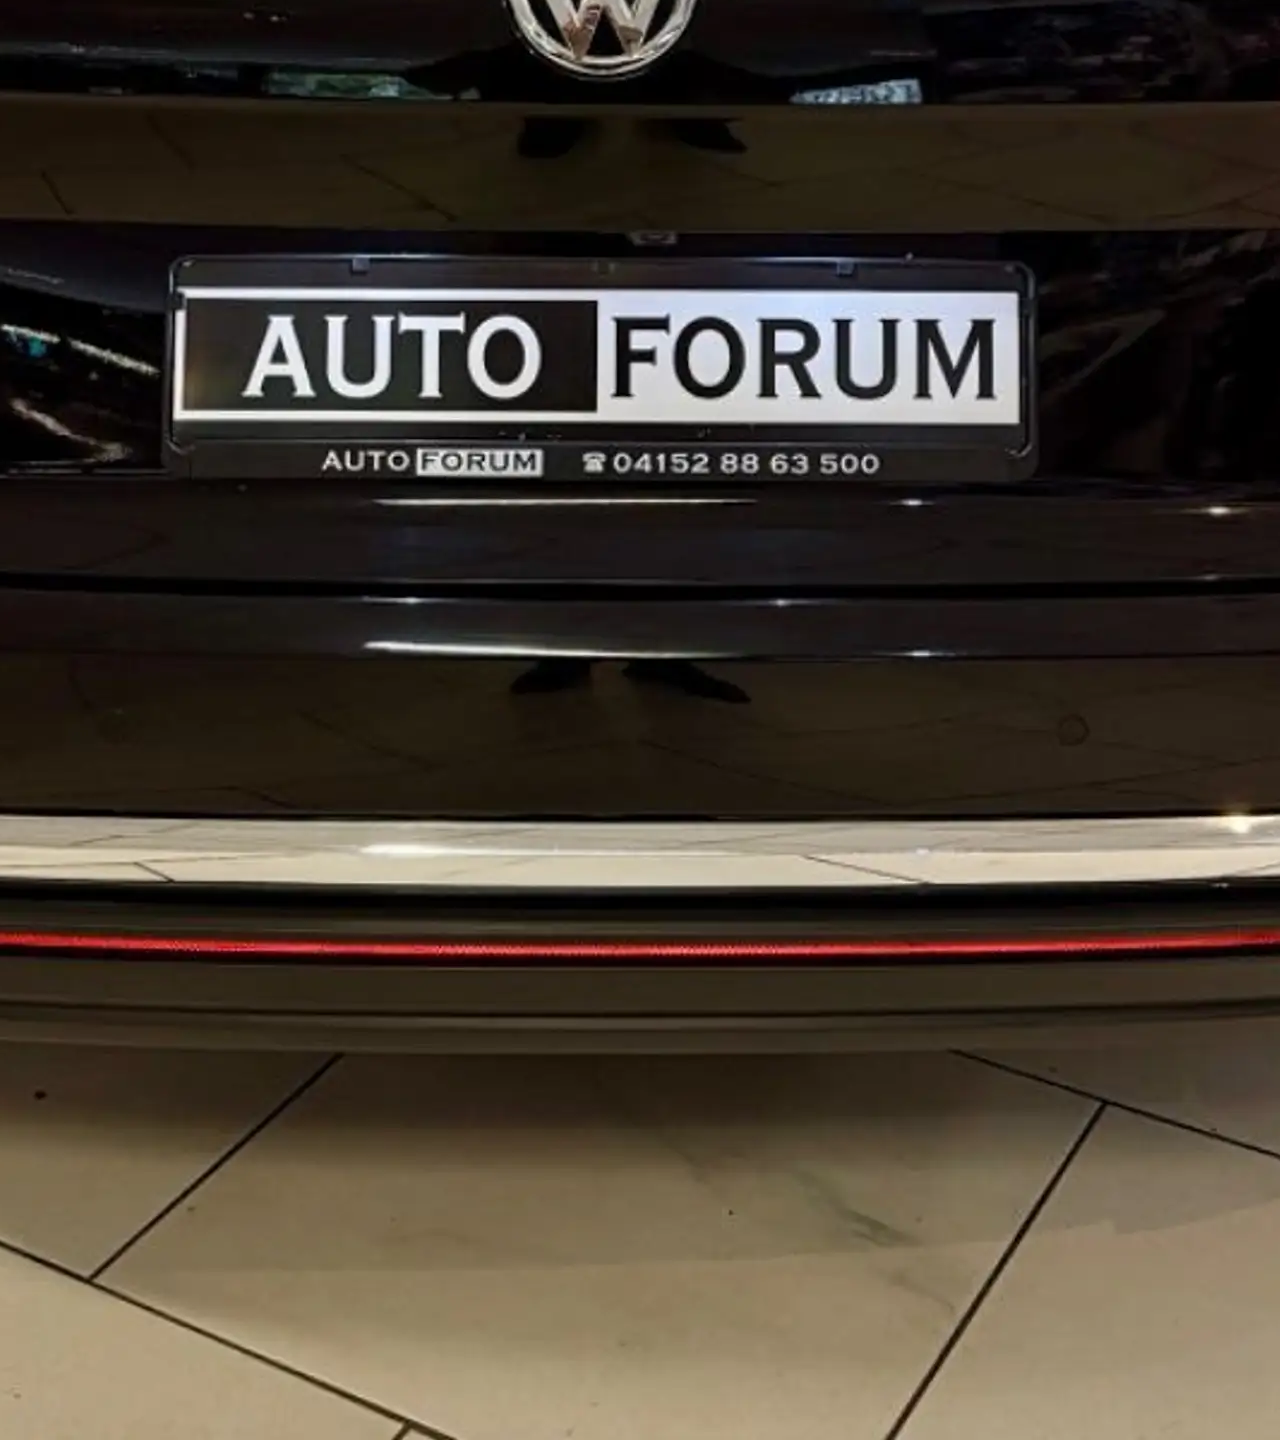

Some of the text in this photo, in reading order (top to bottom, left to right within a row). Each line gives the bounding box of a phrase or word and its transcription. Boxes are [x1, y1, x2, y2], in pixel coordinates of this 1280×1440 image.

[241, 312, 998, 401] AUTO FORUM
[321, 449, 880, 475] AUTO FORUM 04152 88 63 500
